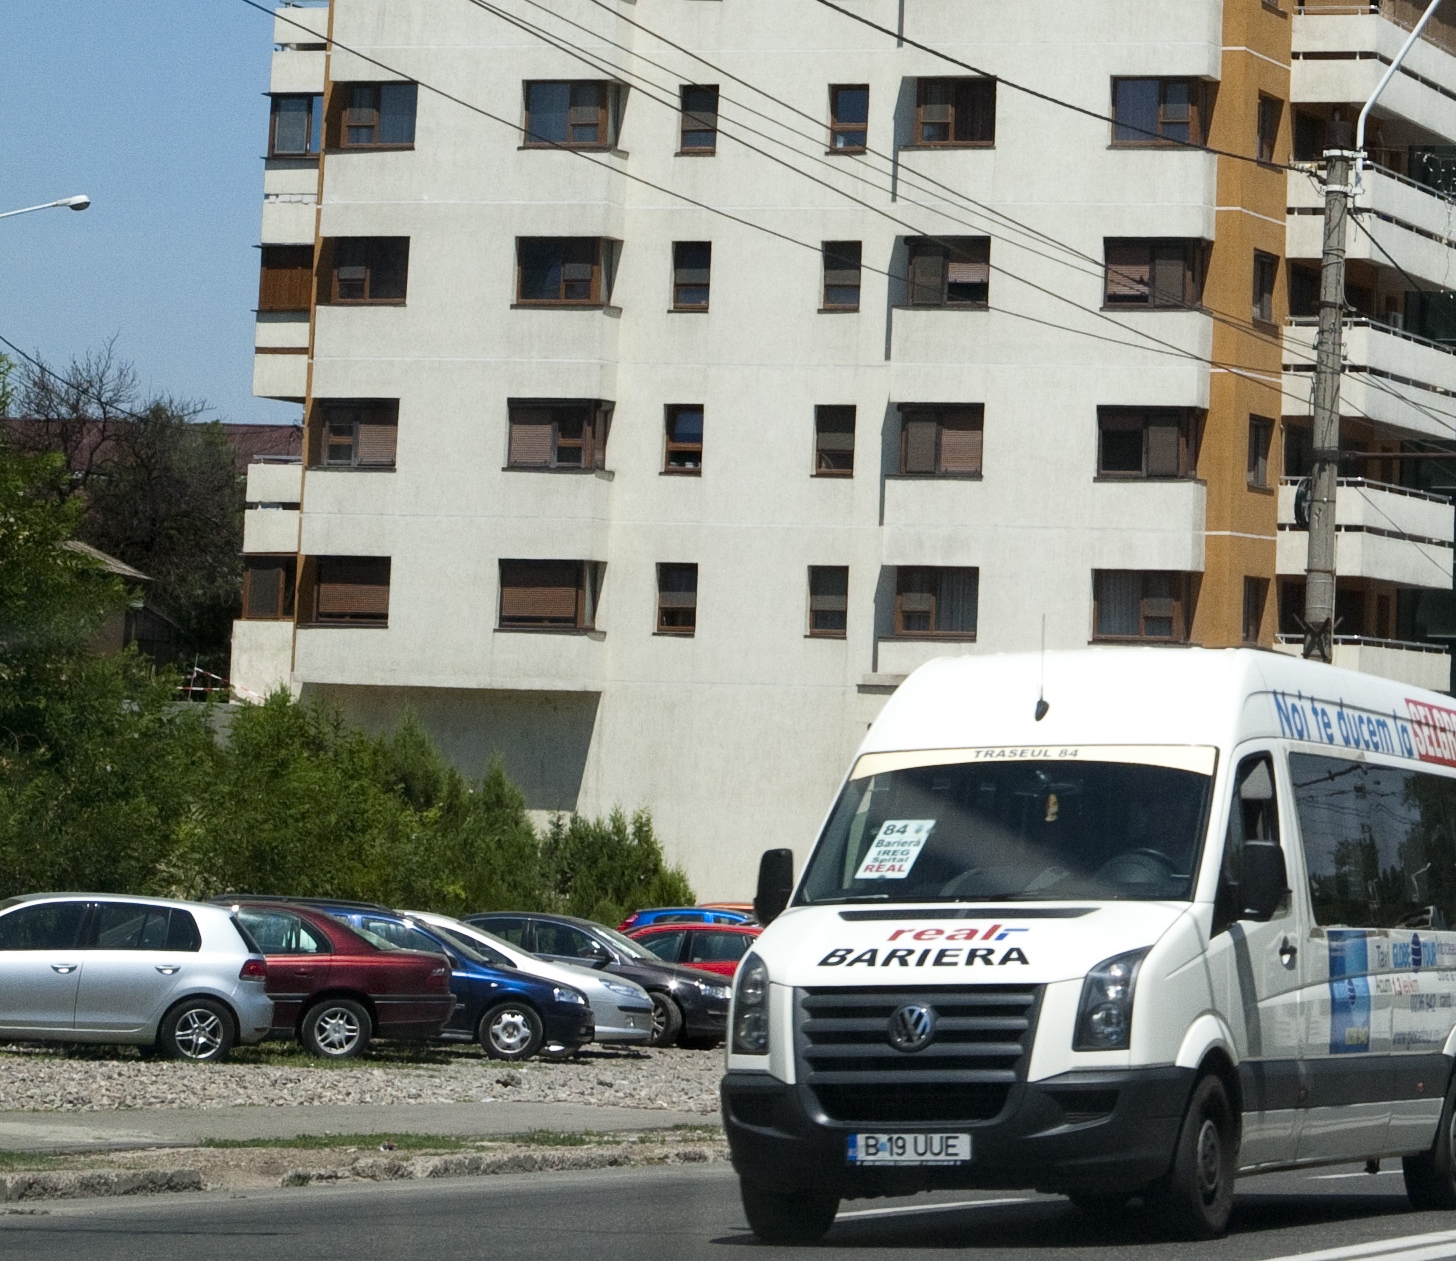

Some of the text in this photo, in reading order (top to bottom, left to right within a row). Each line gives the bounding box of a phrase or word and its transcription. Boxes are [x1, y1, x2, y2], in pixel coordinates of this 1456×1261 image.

[1272, 689, 1311, 741] Noi
[1311, 695, 1334, 745] te
[1337, 697, 1395, 754] ducem
[1393, 708, 1415, 759] la
[973, 748, 1079, 759] TRASEUL 84
[883, 823, 908, 836] 84
[863, 864, 906, 873] REAL
[817, 947, 1030, 967] BARIERA
[864, 1135, 960, 1157] B 19 UUE
